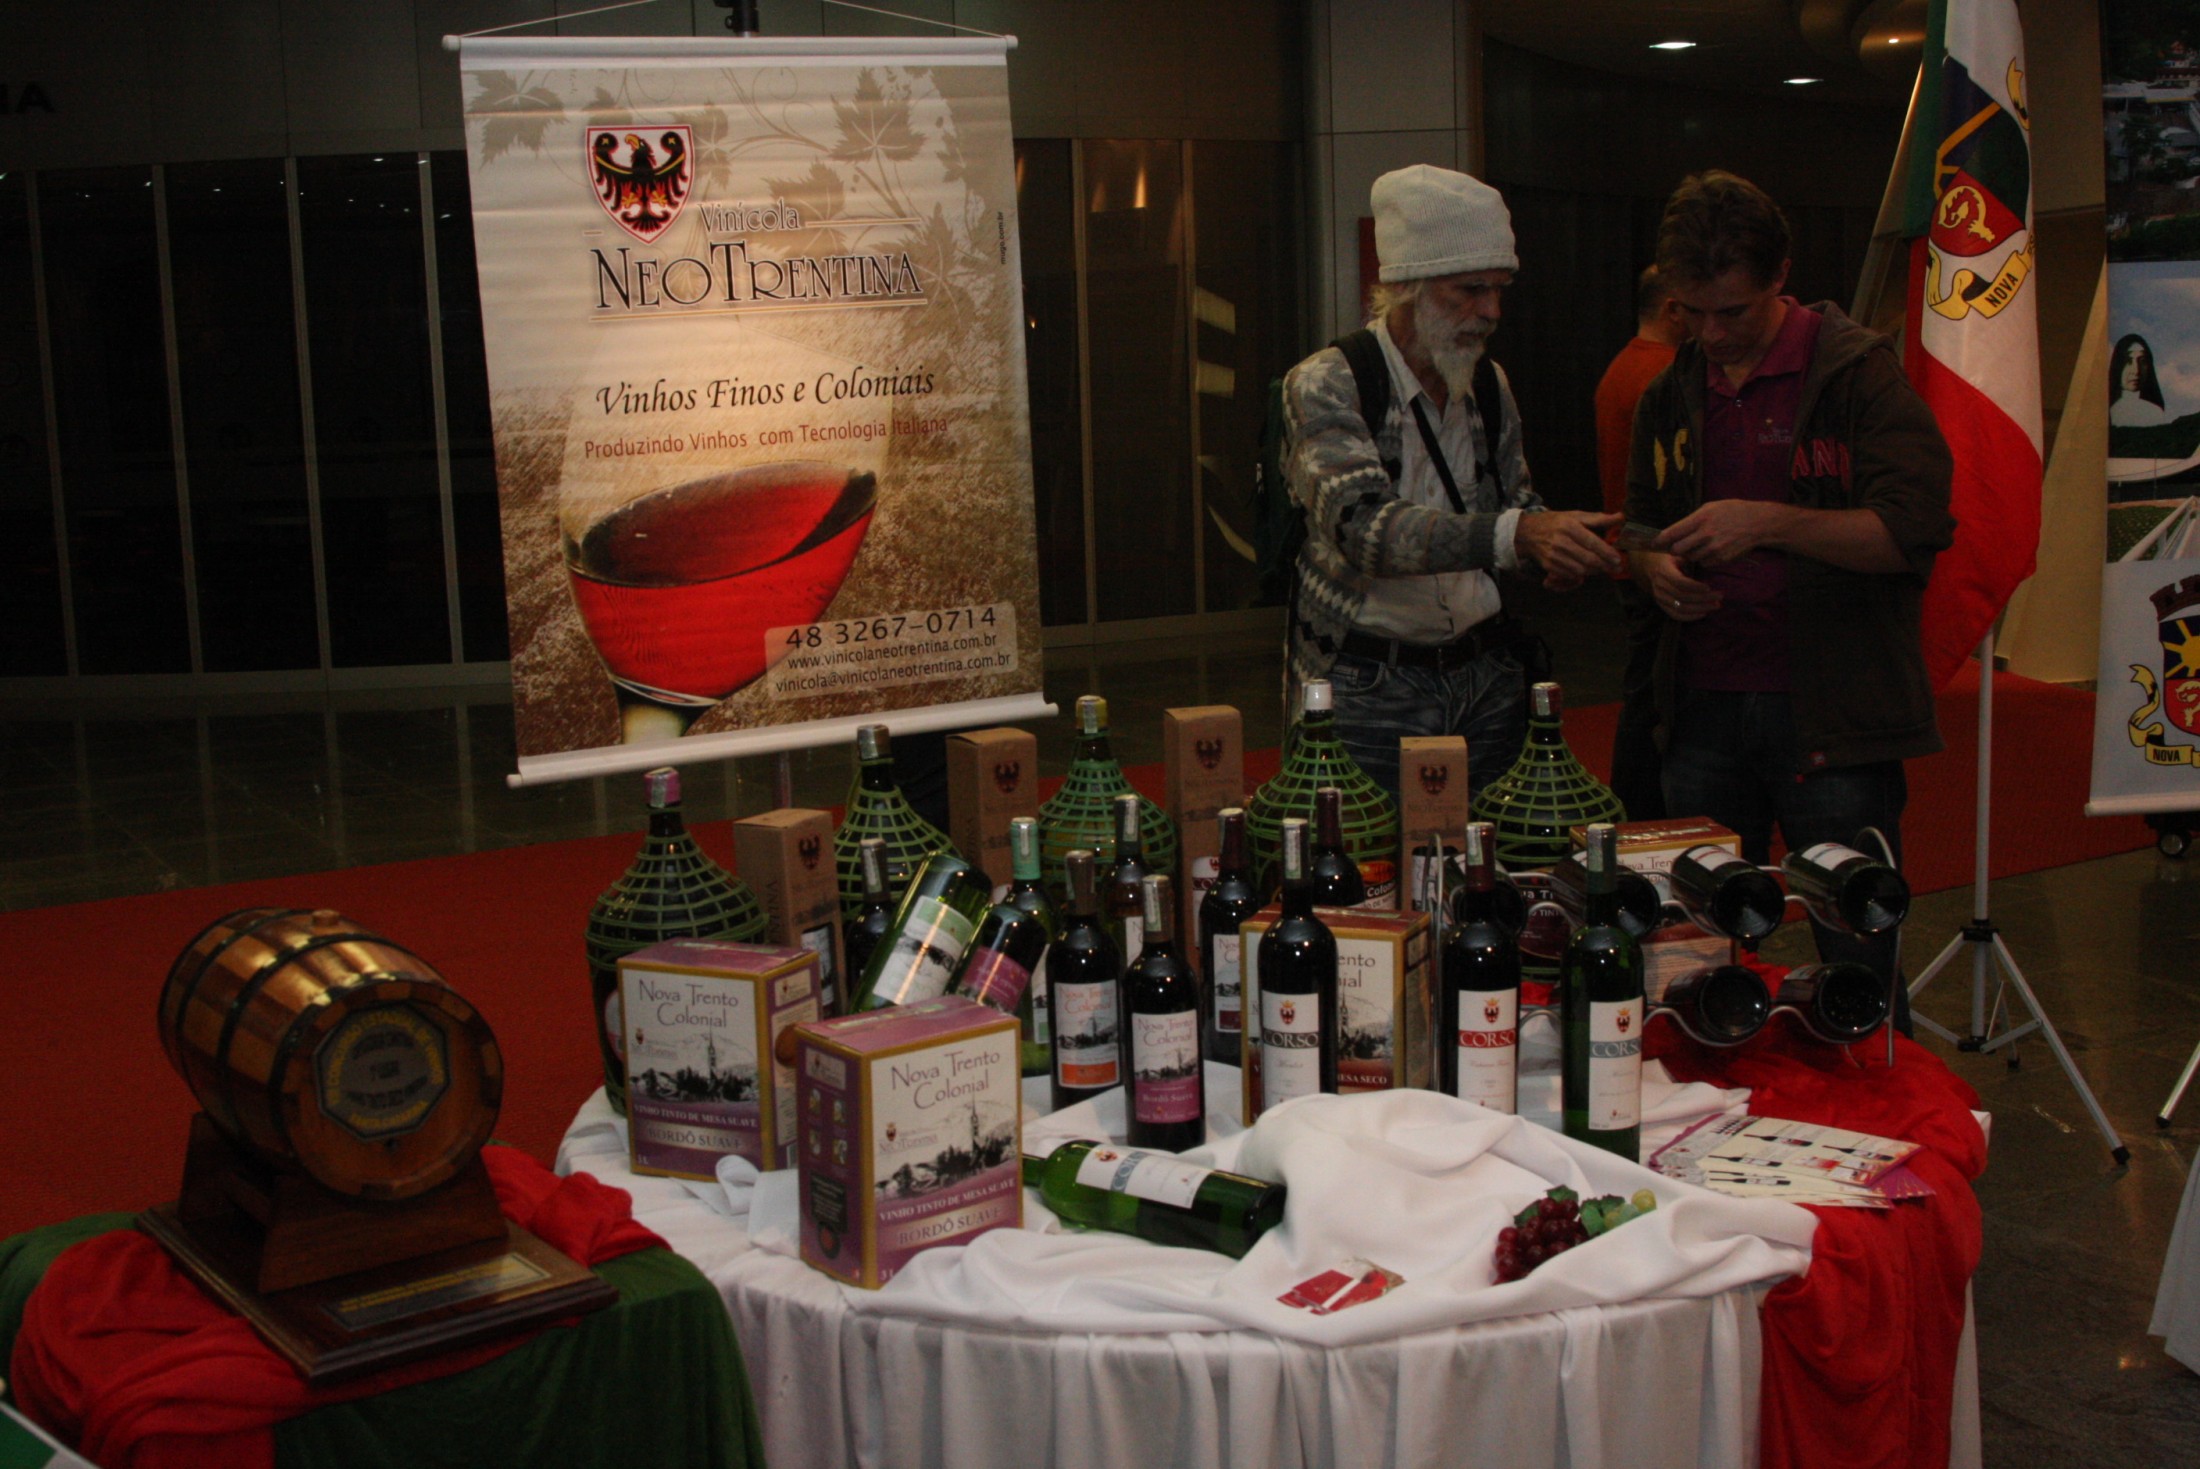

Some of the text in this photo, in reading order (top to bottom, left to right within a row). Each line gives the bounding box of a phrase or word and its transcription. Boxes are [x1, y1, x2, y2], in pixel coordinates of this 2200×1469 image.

[697, 197, 800, 233] Vinícola
[590, 240, 923, 310] NEOTRENTINA
[1985, 272, 2019, 308] NOVA
[598, 365, 935, 415] Vinhos Finos e Coloniais
[584, 417, 948, 458] Produzindo Vinhos com Tecnologia Italiana
[786, 606, 996, 650] 48 3267-0714
[788, 633, 997, 669] www.vinicolaneotrentina.com.br
[776, 652, 1011, 692] vinicola@vinicolaneotrentina.com.br
[2153, 749, 2181, 762] NOVA
[1646, 855, 1673, 869] Tren
[1337, 954, 1376, 968] ento
[638, 978, 740, 1008] Nova Trento
[656, 1001, 729, 1029] Colonial
[1137, 1018, 1165, 1031] Nova
[1143, 1027, 1193, 1046] Colonial
[1263, 1031, 1319, 1048] CORSO
[1459, 1029, 1516, 1047] CORSO
[1591, 1037, 1640, 1057] CORS
[891, 1050, 1000, 1090] Nova Trento
[1360, 1075, 1387, 1085] SECO
[913, 1069, 989, 1110] Colonial
[635, 1103, 758, 1128] VINHO TINTO DE MESA SUAVE
[647, 1126, 743, 1151] BORDÔ SUAVE
[880, 1177, 1017, 1223] VINHO TINTO DE MESA SUAVE
[898, 1205, 1003, 1246] BORDÔ SUAVE
